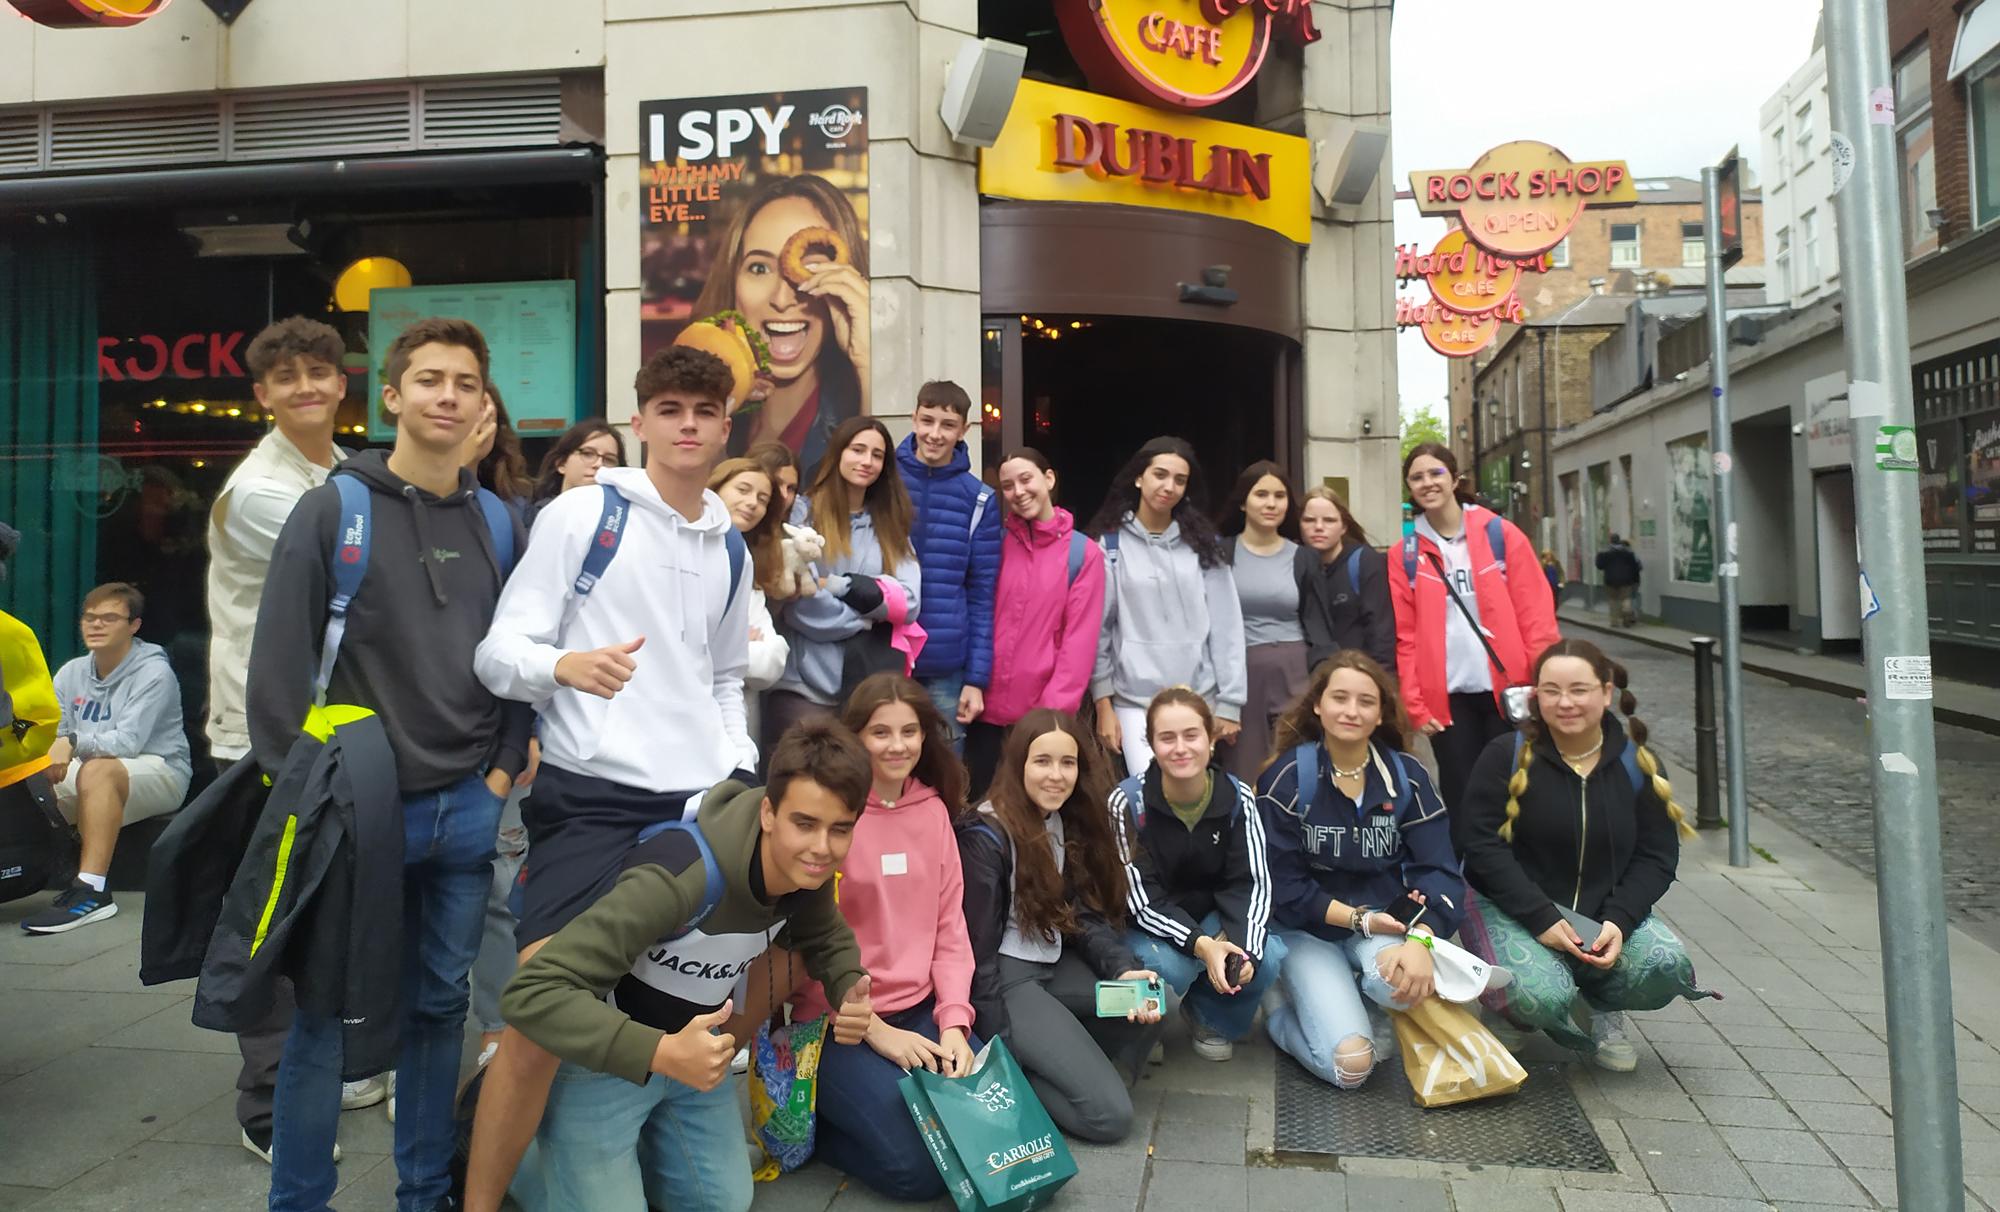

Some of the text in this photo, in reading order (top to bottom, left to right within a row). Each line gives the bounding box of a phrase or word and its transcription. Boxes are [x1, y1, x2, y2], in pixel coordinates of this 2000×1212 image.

[1139, 12, 1224, 66] CAFE
[649, 105, 795, 162] I SPY
[650, 163, 745, 185] WITH MY
[1052, 113, 1273, 201] DUBLIN
[650, 184, 721, 204] LITTLE
[1427, 165, 1625, 202] ROCK SHOP
[650, 204, 706, 223] EYE...
[1484, 211, 1558, 234] OPEN
[1395, 241, 1470, 277] Hard
[1453, 280, 1497, 297] CAFE
[1440, 329, 1477, 344] CAFE
[97, 331, 245, 382] ROCK
[985, 1132, 1052, 1168] CARROLLS
